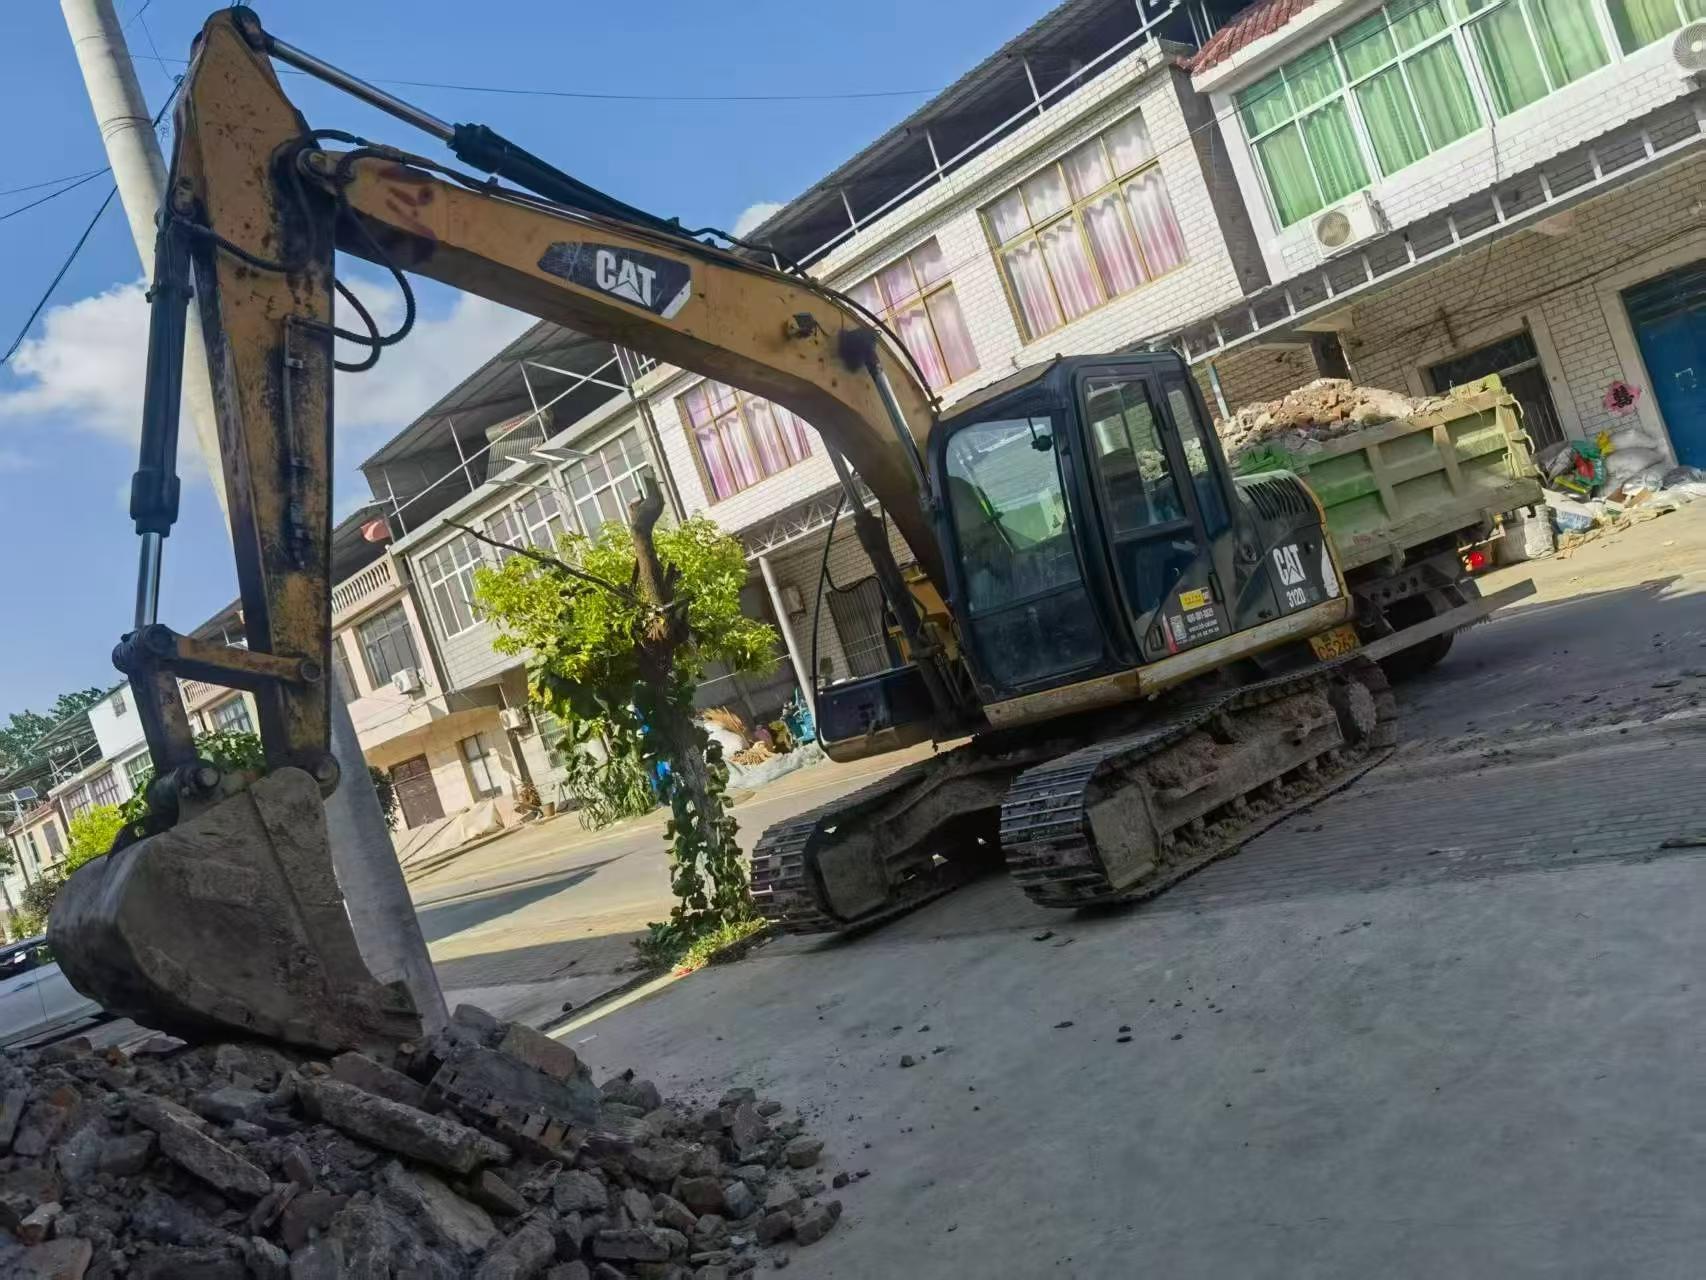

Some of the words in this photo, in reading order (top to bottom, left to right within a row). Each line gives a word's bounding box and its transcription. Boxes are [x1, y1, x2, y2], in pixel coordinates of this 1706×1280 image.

[596, 249, 656, 307] CAT
[1272, 543, 1306, 586] CAT
[1286, 587, 1306, 608] 312D
